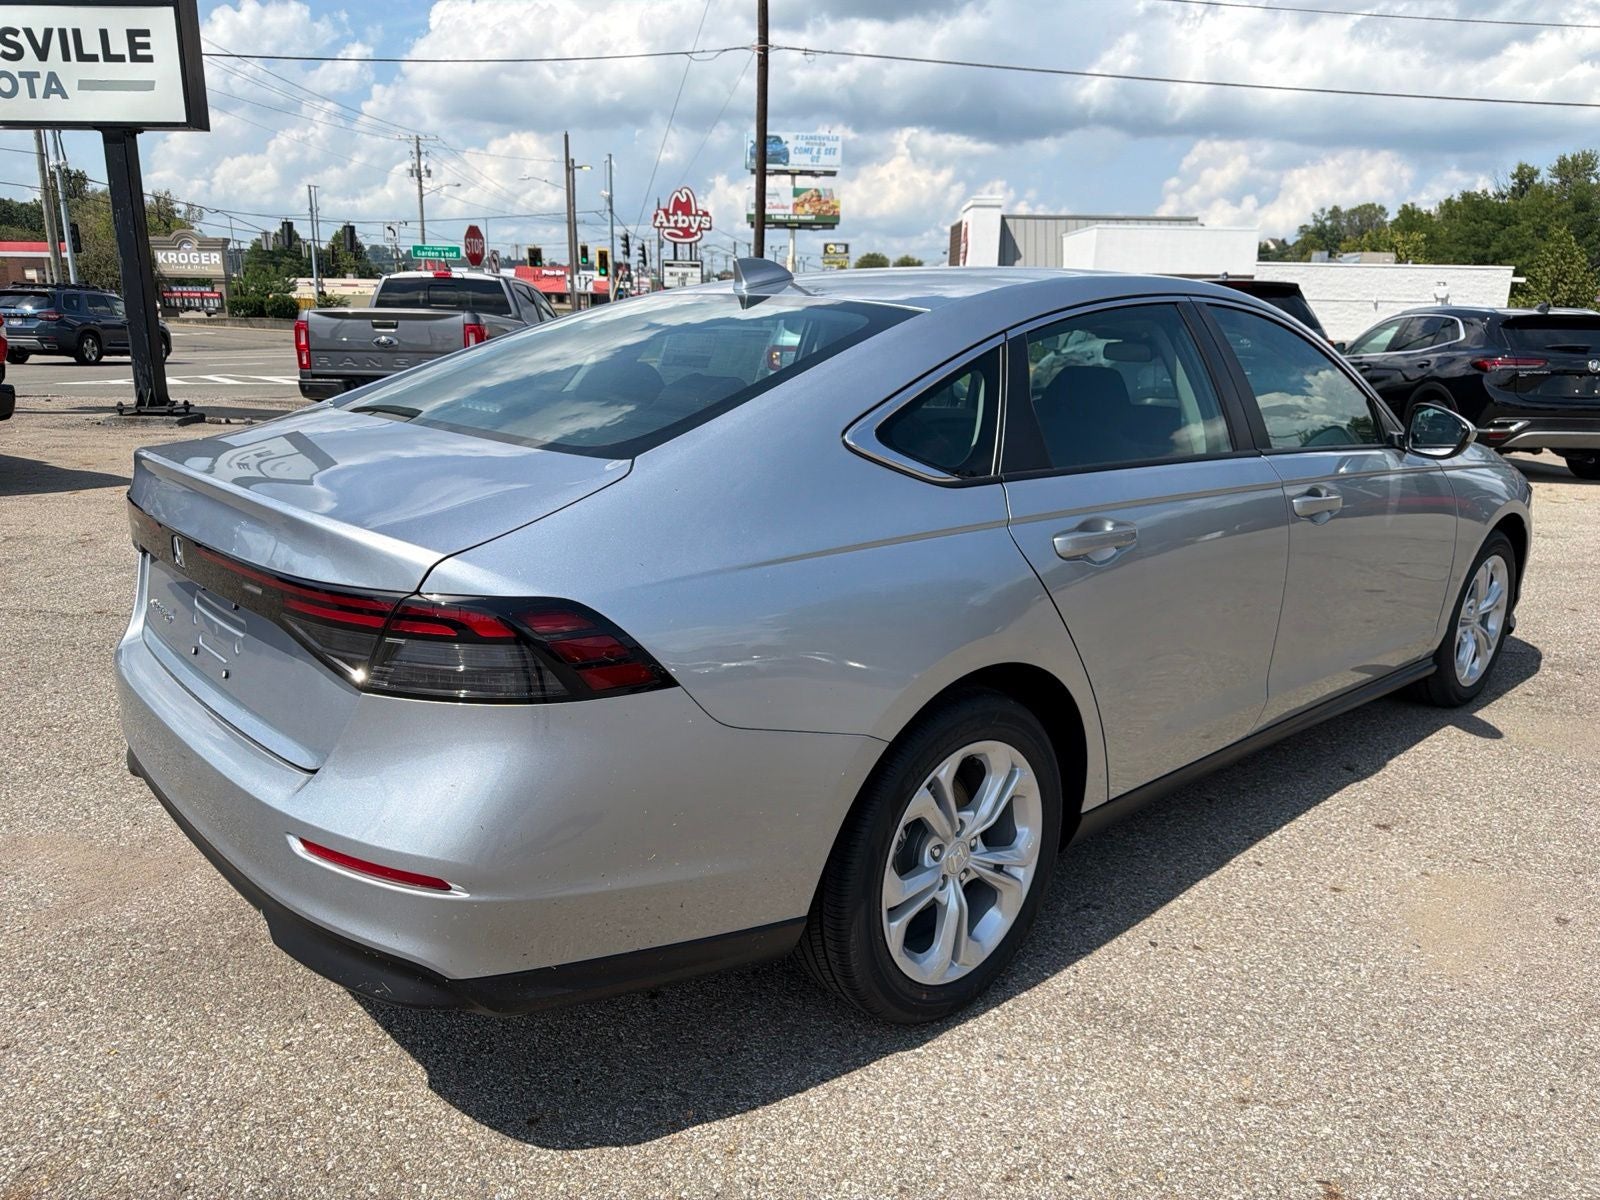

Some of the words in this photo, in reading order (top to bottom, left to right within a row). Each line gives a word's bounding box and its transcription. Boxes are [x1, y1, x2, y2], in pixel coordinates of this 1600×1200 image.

[0, 27, 154, 63] SVILLE
[0, 70, 69, 100] OTA
[654, 210, 711, 233] Arby's
[466, 238, 483, 254] STOP
[157, 252, 220, 264] KROGER
